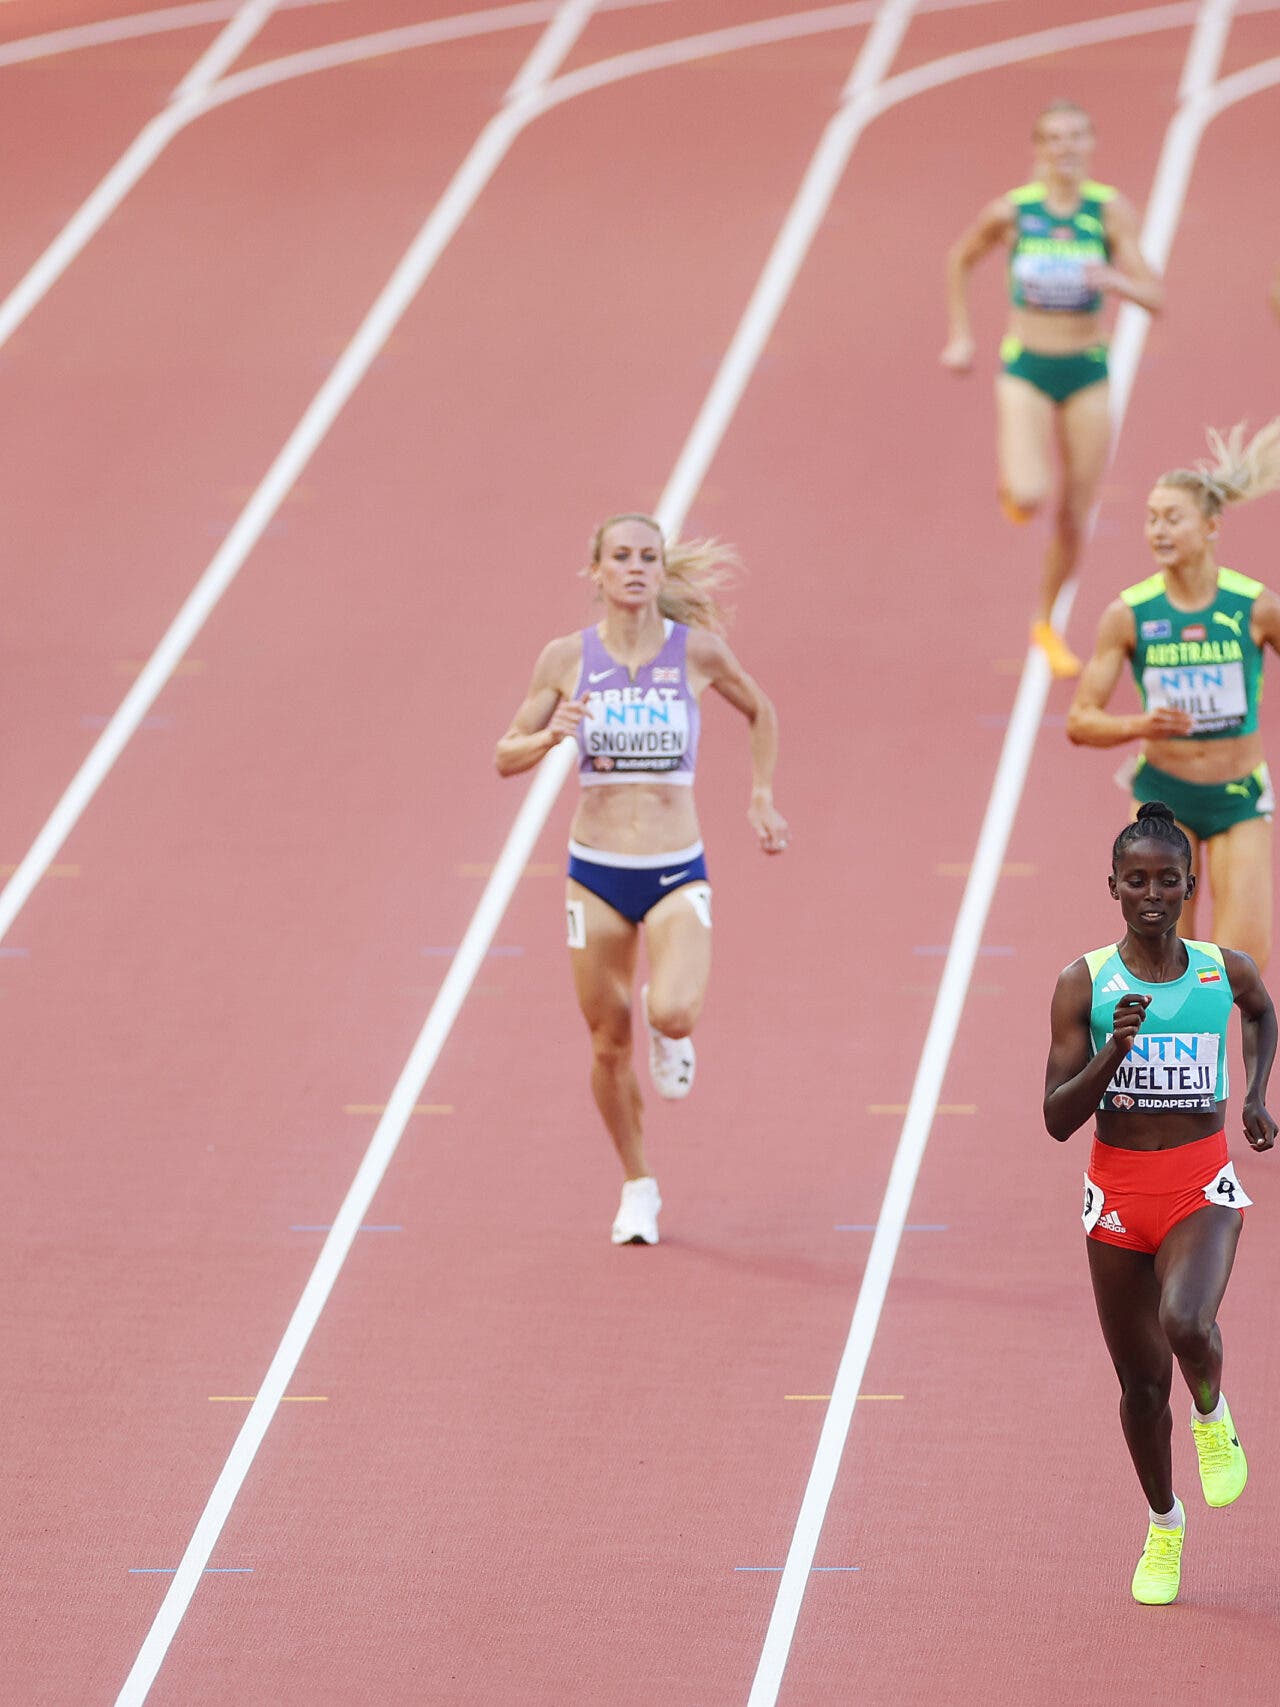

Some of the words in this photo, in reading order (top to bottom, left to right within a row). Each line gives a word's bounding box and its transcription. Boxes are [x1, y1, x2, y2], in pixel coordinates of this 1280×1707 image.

[1146, 641, 1243, 666] AUSTRALIA
[1161, 667, 1225, 690] NTN
[605, 704, 669, 724] NTN
[590, 731, 683, 752] SNOWDEN
[1125, 1036, 1199, 1062] NTN
[1113, 1066, 1211, 1090] WELTEJI
[1138, 1098, 1199, 1109] BUDAPEST
[1097, 1219, 1127, 1234] adidas
